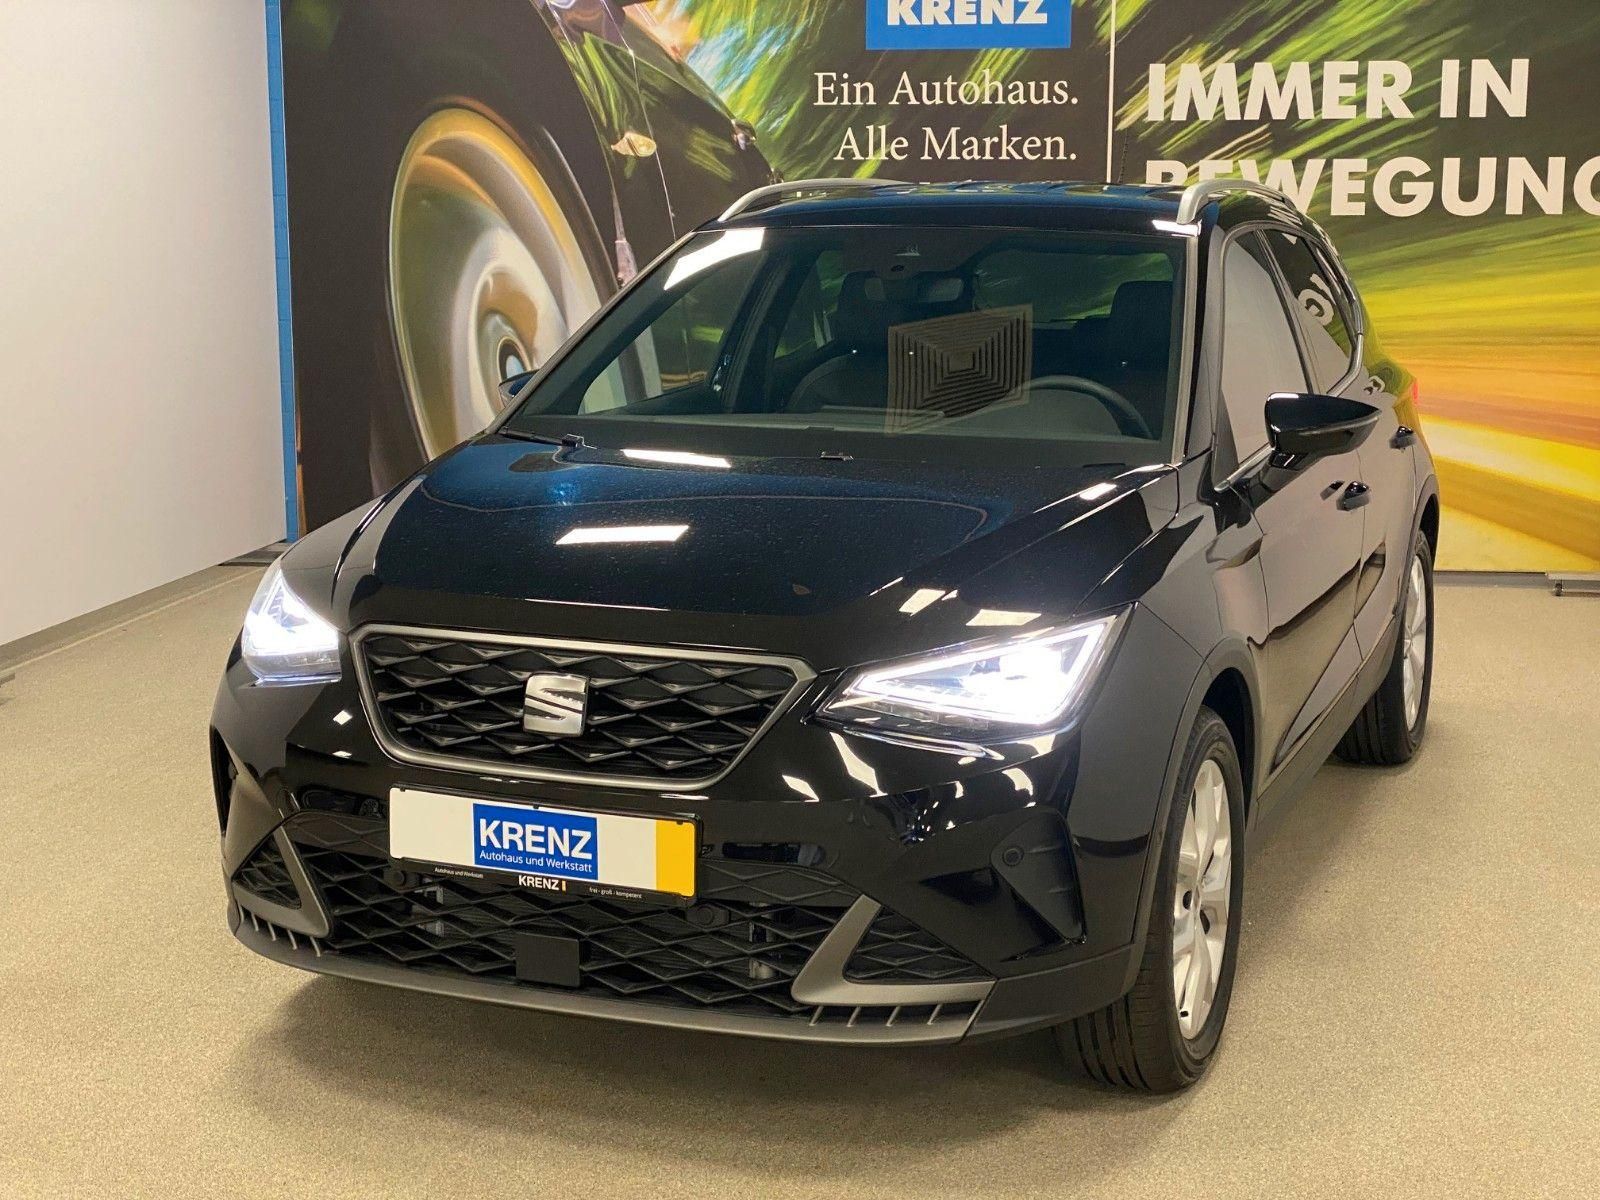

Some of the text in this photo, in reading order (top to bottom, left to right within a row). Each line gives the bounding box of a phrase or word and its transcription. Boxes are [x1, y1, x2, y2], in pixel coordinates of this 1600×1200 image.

[887, 0, 1048, 26] KRENZ
[813, 69, 1079, 106] Ein Autohaus.
[1145, 58, 1530, 122] IMMER IN
[832, 124, 1077, 161] Alle Marken.
[479, 818, 593, 860] KRENZ
[480, 850, 593, 873] Autohaus und Werkstatt
[518, 874, 560, 891] KRENZ
